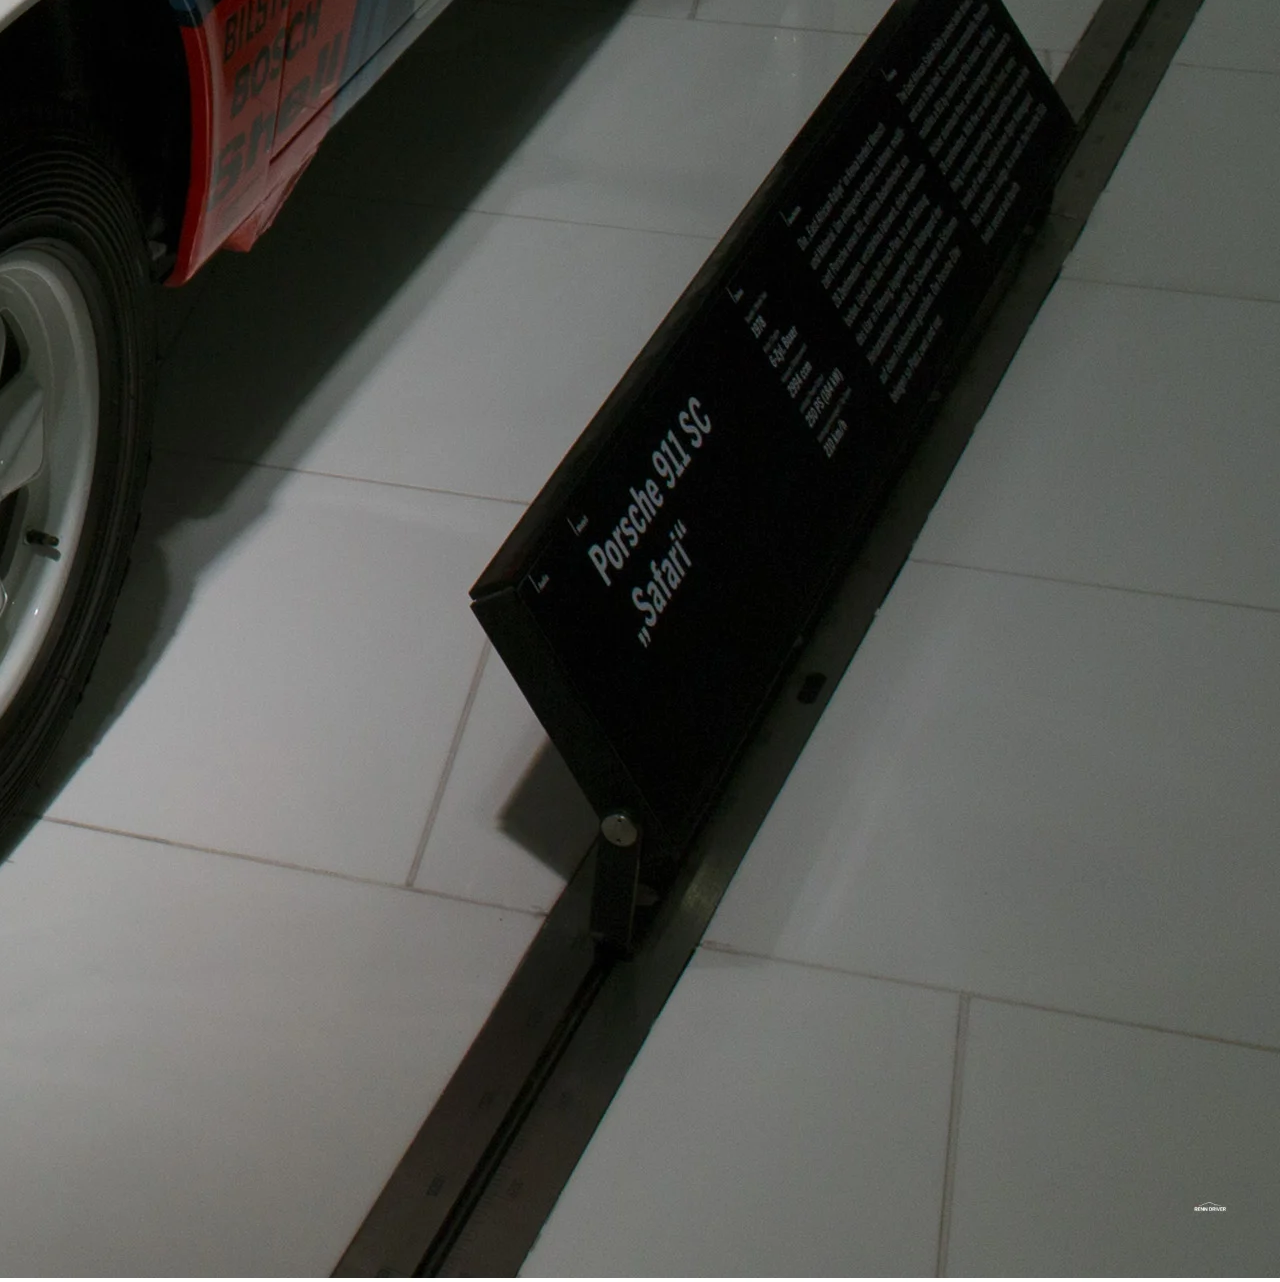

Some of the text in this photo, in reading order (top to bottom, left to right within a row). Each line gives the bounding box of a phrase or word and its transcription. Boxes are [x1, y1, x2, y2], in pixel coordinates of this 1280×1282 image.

[212, 30, 344, 202] Shell
[588, 397, 711, 586] Porsche 911 SC
